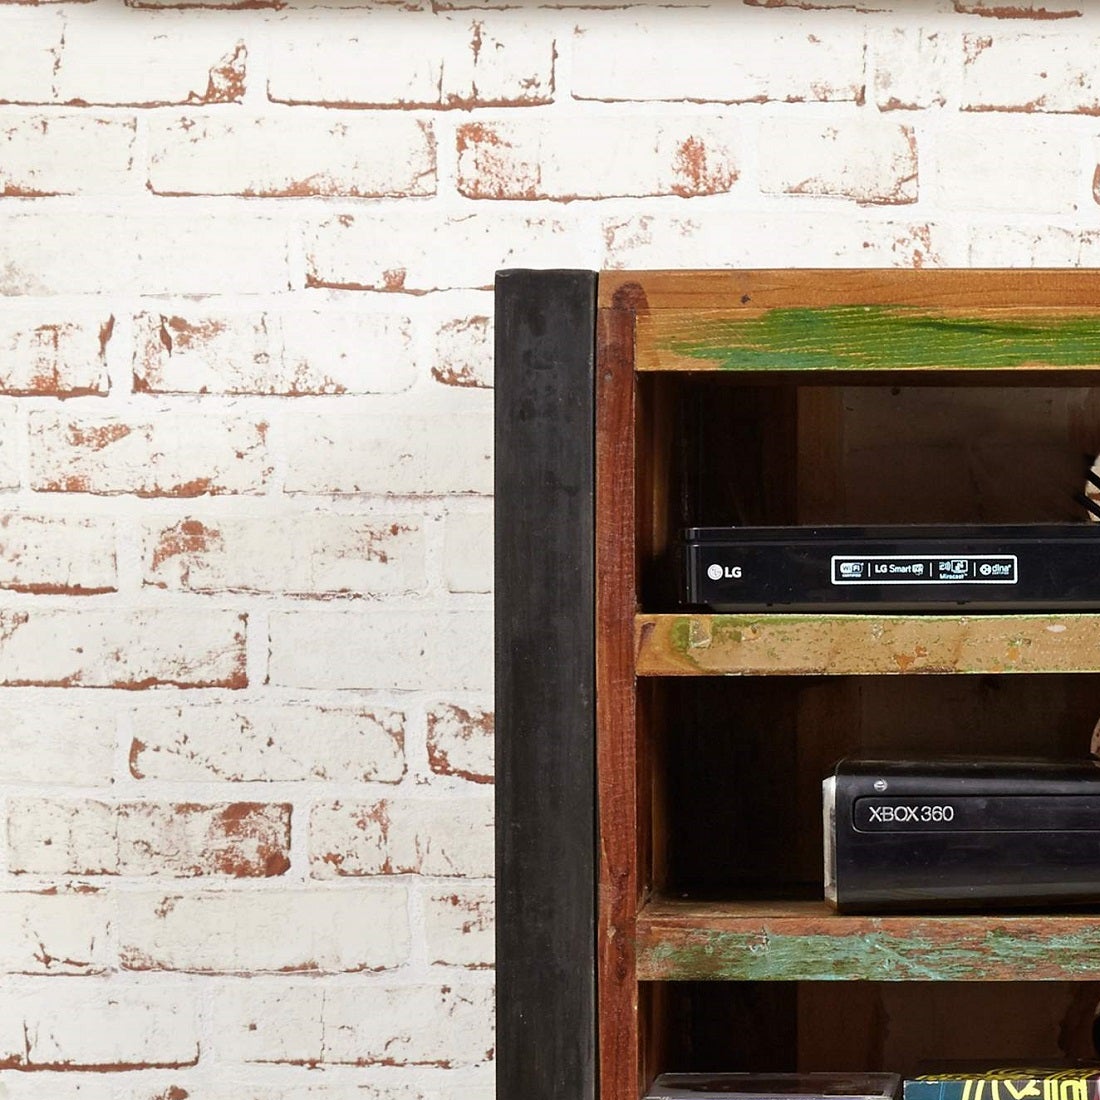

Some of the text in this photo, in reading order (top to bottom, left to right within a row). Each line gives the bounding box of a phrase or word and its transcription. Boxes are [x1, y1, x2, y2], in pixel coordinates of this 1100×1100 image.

[725, 566, 742, 579] LG
[875, 564, 887, 573] LG
[889, 564, 911, 573] Smart
[920, 806, 954, 822] 360
